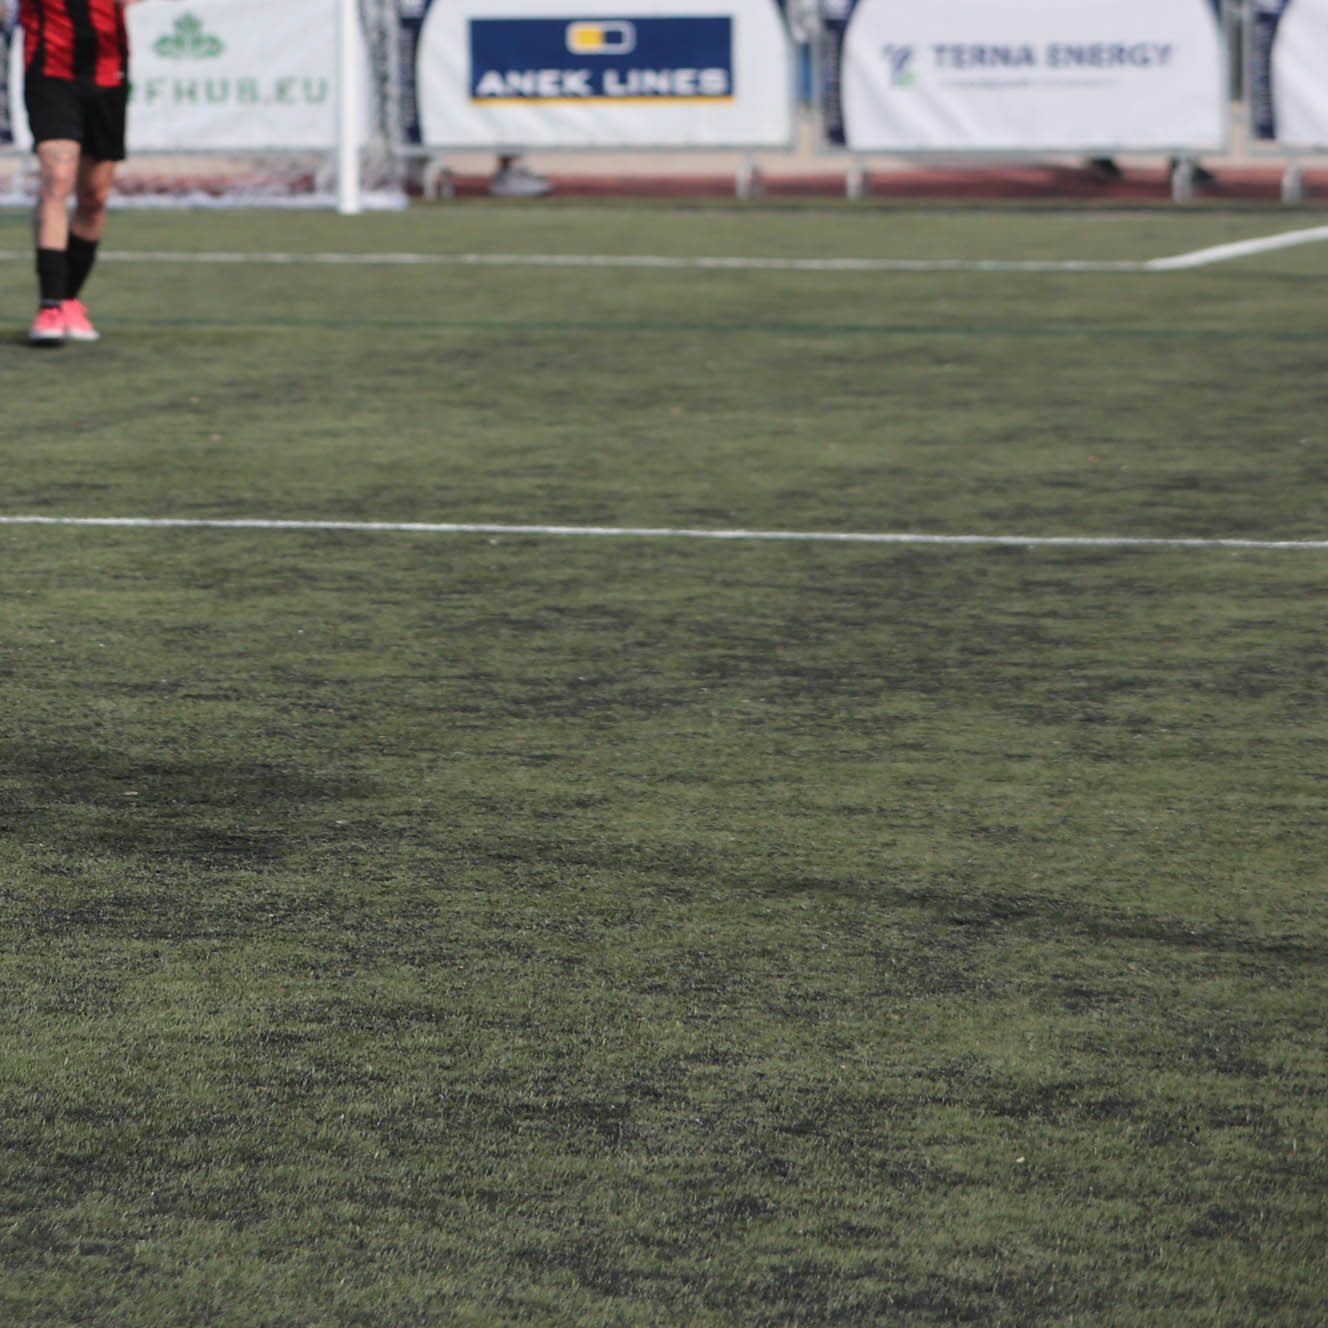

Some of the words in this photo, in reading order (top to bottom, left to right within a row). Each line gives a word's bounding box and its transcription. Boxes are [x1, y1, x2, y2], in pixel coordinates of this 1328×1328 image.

[931, 43, 1039, 68] TERNA
[1047, 42, 1173, 68] ENERGY
[476, 69, 593, 97] ANEK
[603, 68, 730, 96] LINES
